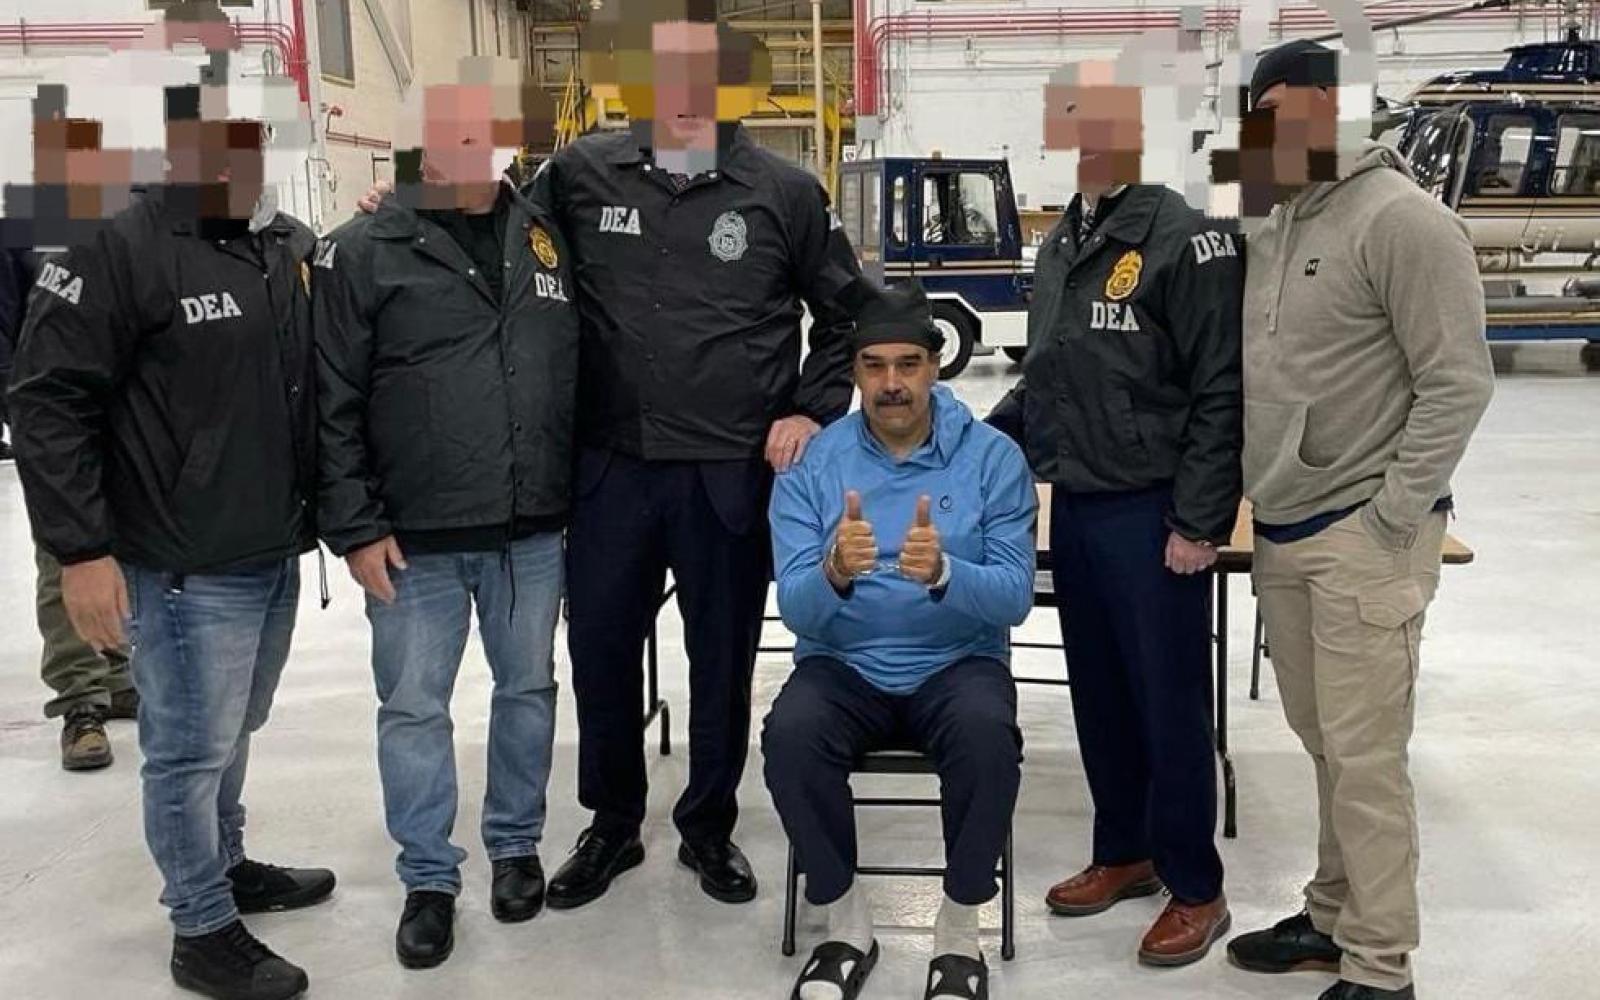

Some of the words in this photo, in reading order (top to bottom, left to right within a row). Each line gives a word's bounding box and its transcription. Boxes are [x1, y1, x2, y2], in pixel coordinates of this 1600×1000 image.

[599, 205, 642, 235] DEA
[1190, 230, 1238, 264] DEA
[35, 262, 84, 305] DEA
[180, 292, 242, 324] DEA
[1090, 301, 1141, 331] DEA
